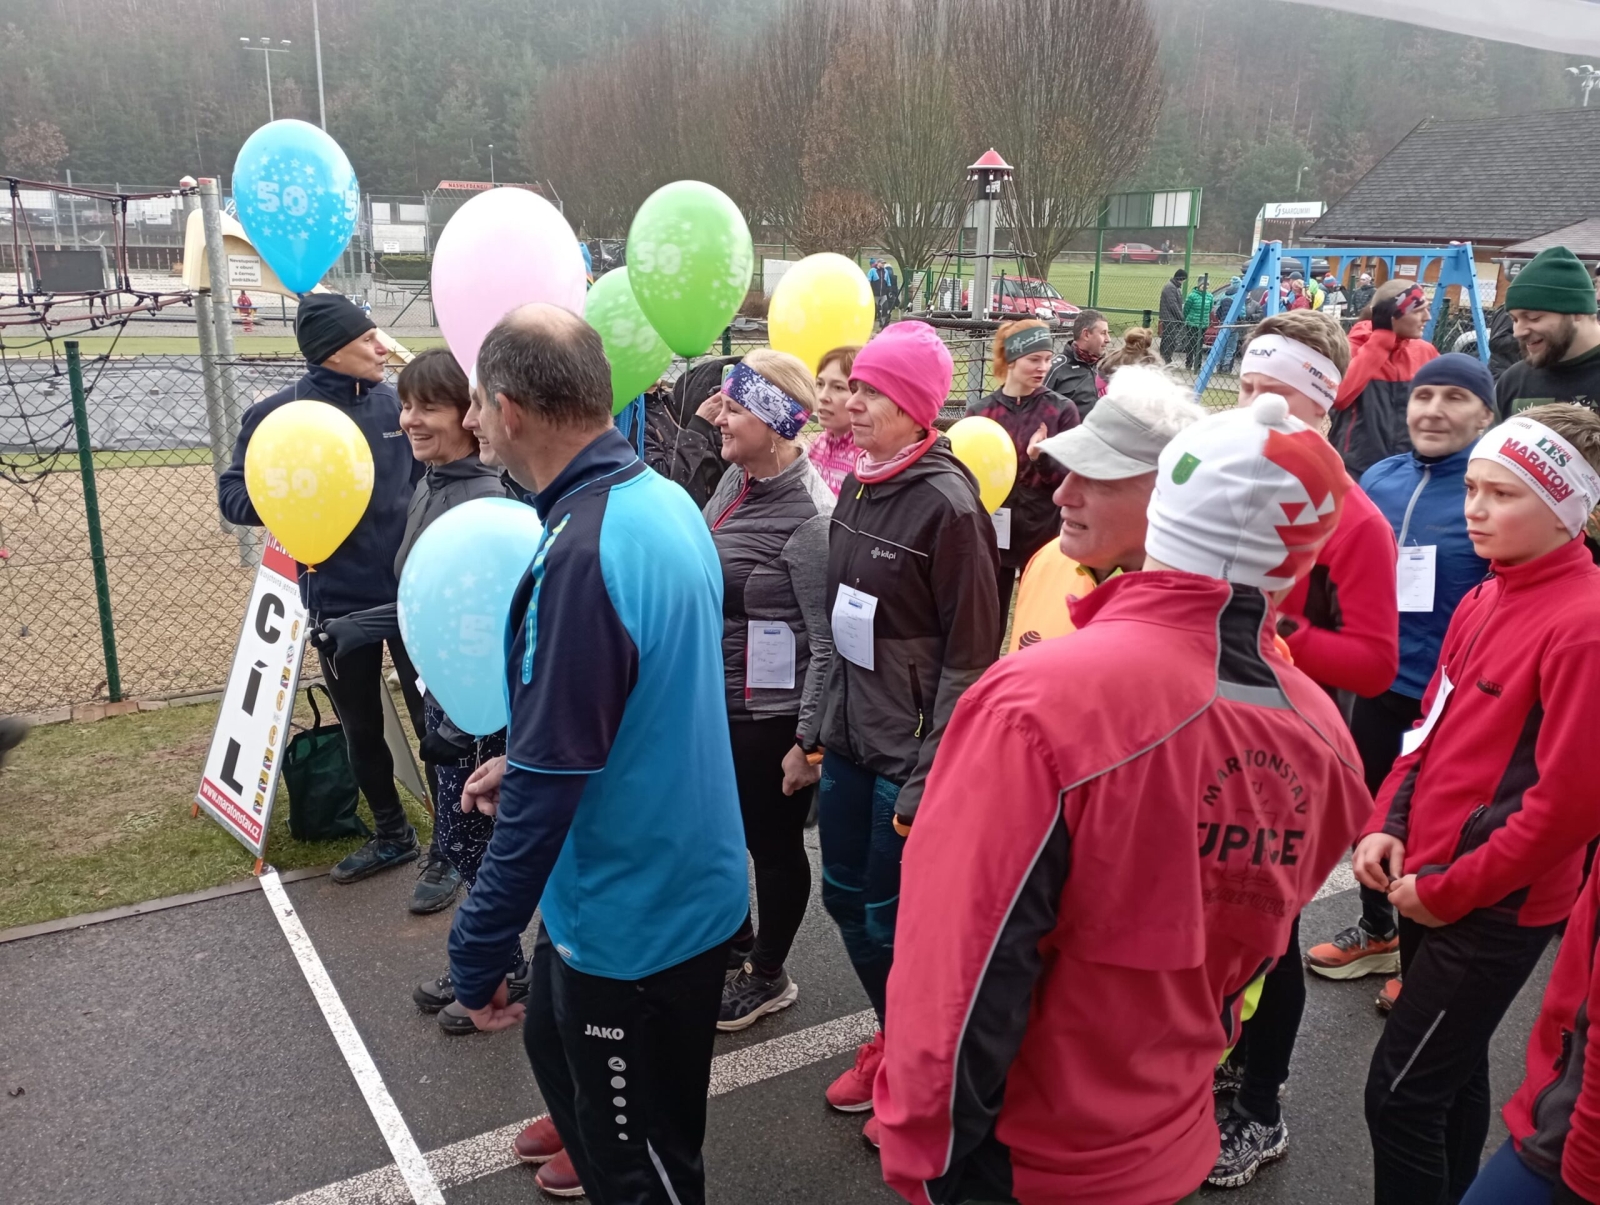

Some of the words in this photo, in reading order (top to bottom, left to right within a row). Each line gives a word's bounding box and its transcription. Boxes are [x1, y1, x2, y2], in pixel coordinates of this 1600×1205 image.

[257, 180, 308, 216] 50
[635, 242, 682, 276] 50
[1504, 437, 1575, 497] MARATON
[1535, 437, 1567, 467] LES
[264, 468, 318, 498] 50
[881, 550, 897, 560] kilpi
[1203, 750, 1306, 814] MARTONSTAV
[202, 782, 260, 839] www.maratonstav.cz
[584, 1023, 624, 1040] JAKO
